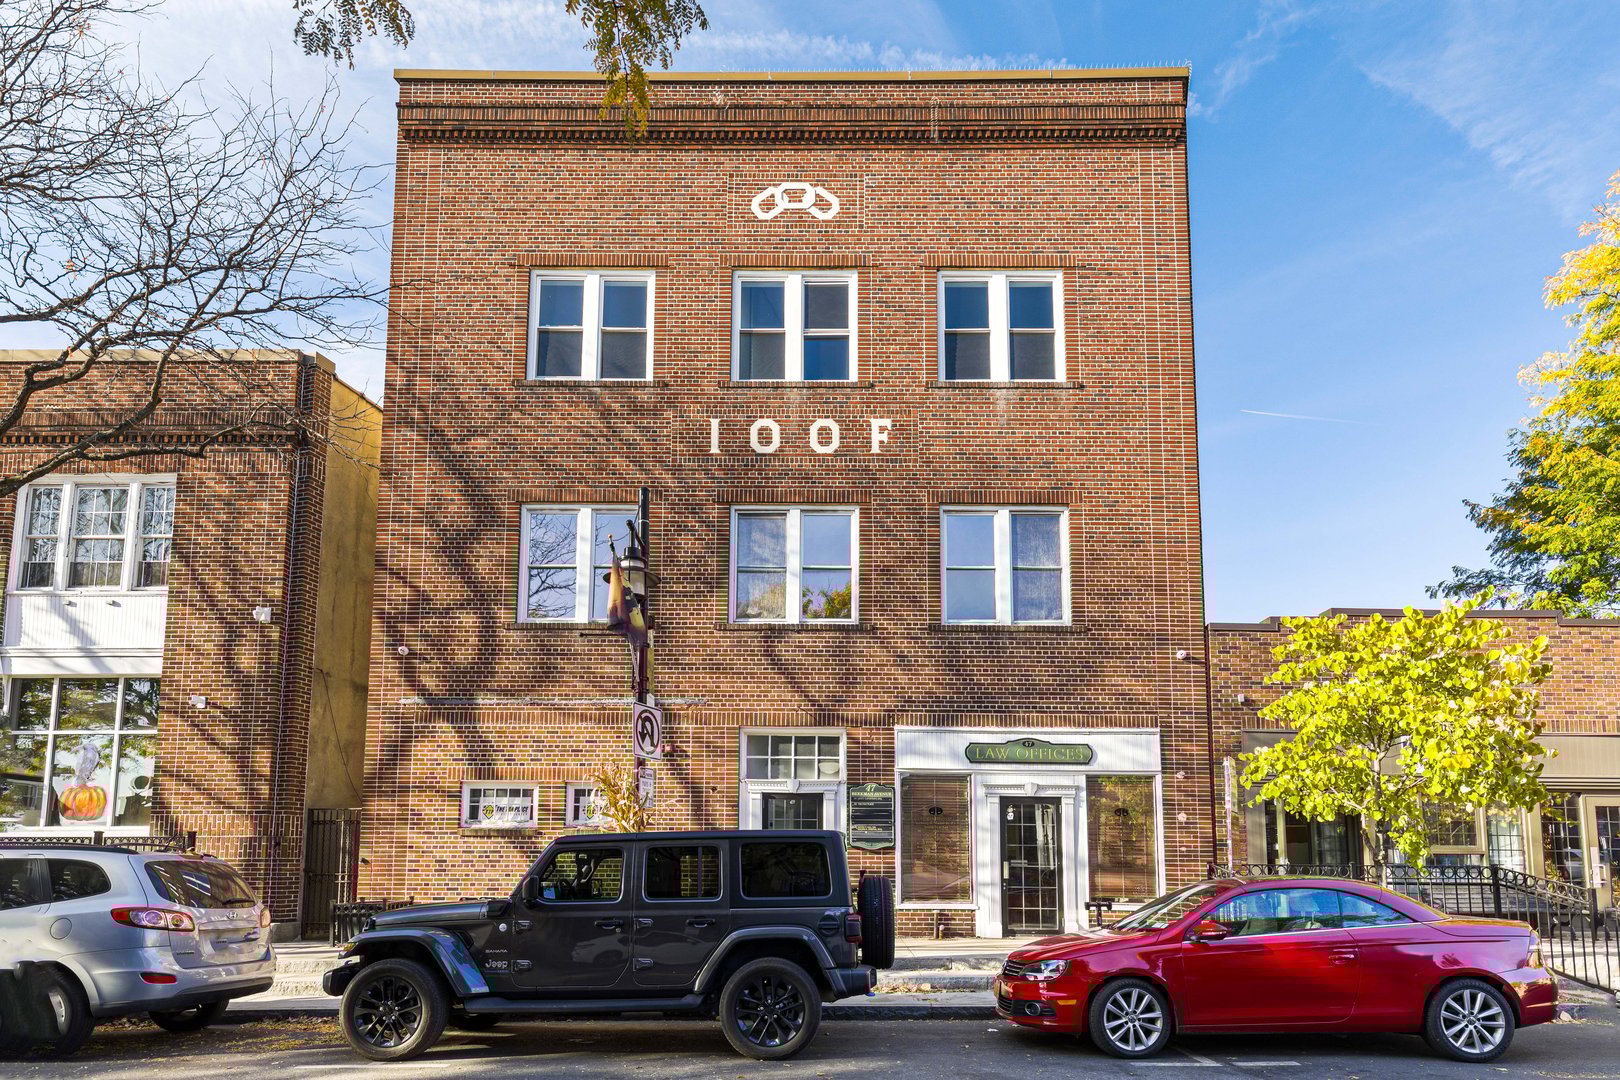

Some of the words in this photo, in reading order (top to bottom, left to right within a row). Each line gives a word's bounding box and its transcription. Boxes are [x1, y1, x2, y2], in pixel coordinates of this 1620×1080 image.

[975, 747, 1009, 760] LAW
[1016, 747, 1084, 760] OFFICES
[865, 784, 876, 792] 47
[484, 959, 509, 970] Jeep
